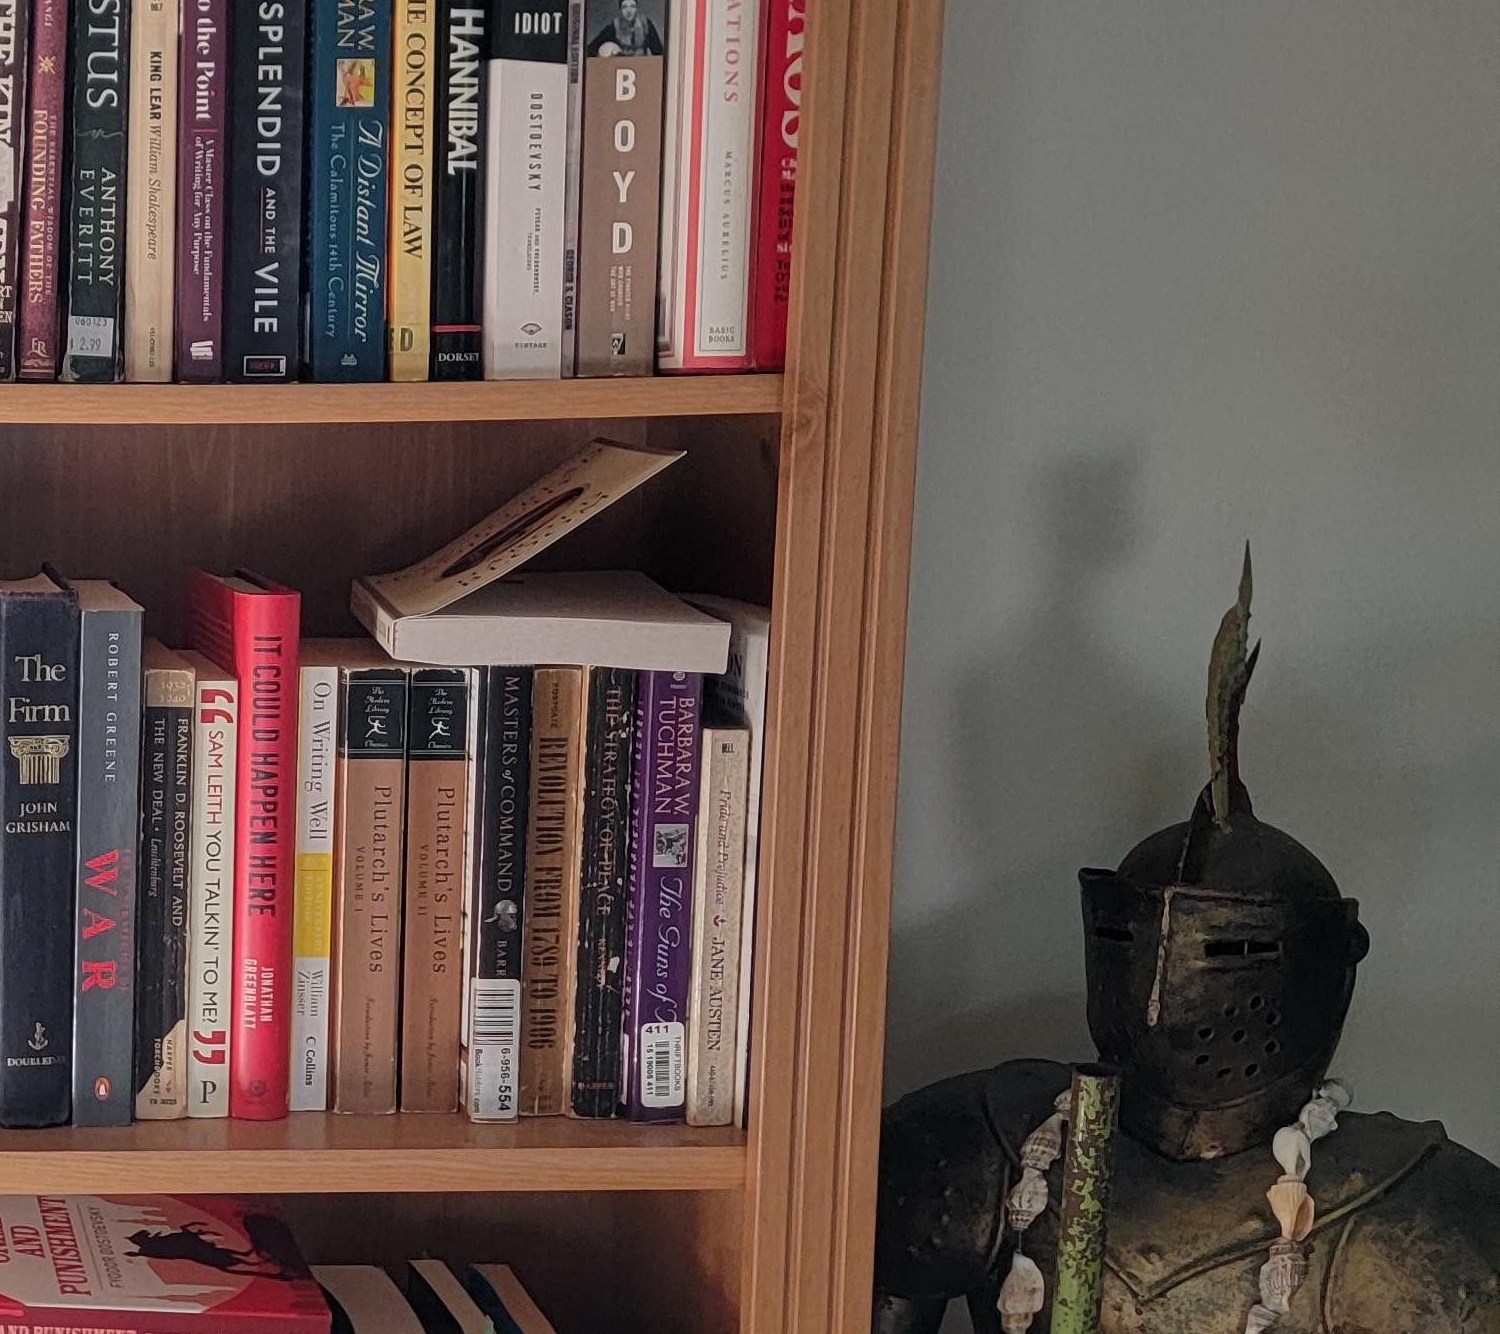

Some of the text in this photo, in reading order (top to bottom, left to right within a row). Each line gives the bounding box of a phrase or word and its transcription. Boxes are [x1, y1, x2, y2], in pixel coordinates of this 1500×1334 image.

[514, 11, 563, 35] IDIOT
[148, 50, 162, 120] KING LEAR
[256, 1, 284, 177] SPLENDID
[404, 33, 427, 159] CONCEPT
[447, 6, 484, 176] HANNIBAL
[28, 108, 48, 304] FOUNDING FATHERS
[145, 123, 162, 260] William Shakespeare
[264, 187, 276, 220] AND
[404, 167, 425, 198] OF
[77, 168, 95, 286] EVERITT
[98, 166, 117, 286] ANTHONY
[264, 226, 276, 254] THE
[403, 205, 423, 260] LAW
[253, 261, 279, 334] VILE
[15, 655, 67, 682] The
[104, 632, 120, 783] ROBERT GREENE
[8, 698, 71, 724] Firm
[205, 730, 223, 825] SAM LEITH
[247, 634, 281, 917] IT COULD HAPPEN HERE
[305, 681, 331, 841] On Writing Well
[654, 697, 675, 814] TUCHMAN
[5, 820, 71, 834] GRISHAM
[19, 801, 58, 816] JOHN
[368, 786, 392, 974] Plutarch's Lives
[243, 958, 259, 1030] GREENBLATT
[707, 936, 725, 1052] JANE AUSTEN
[303, 1049, 315, 1086] Collins
[497, 1047, 512, 1112] 6-956-554
